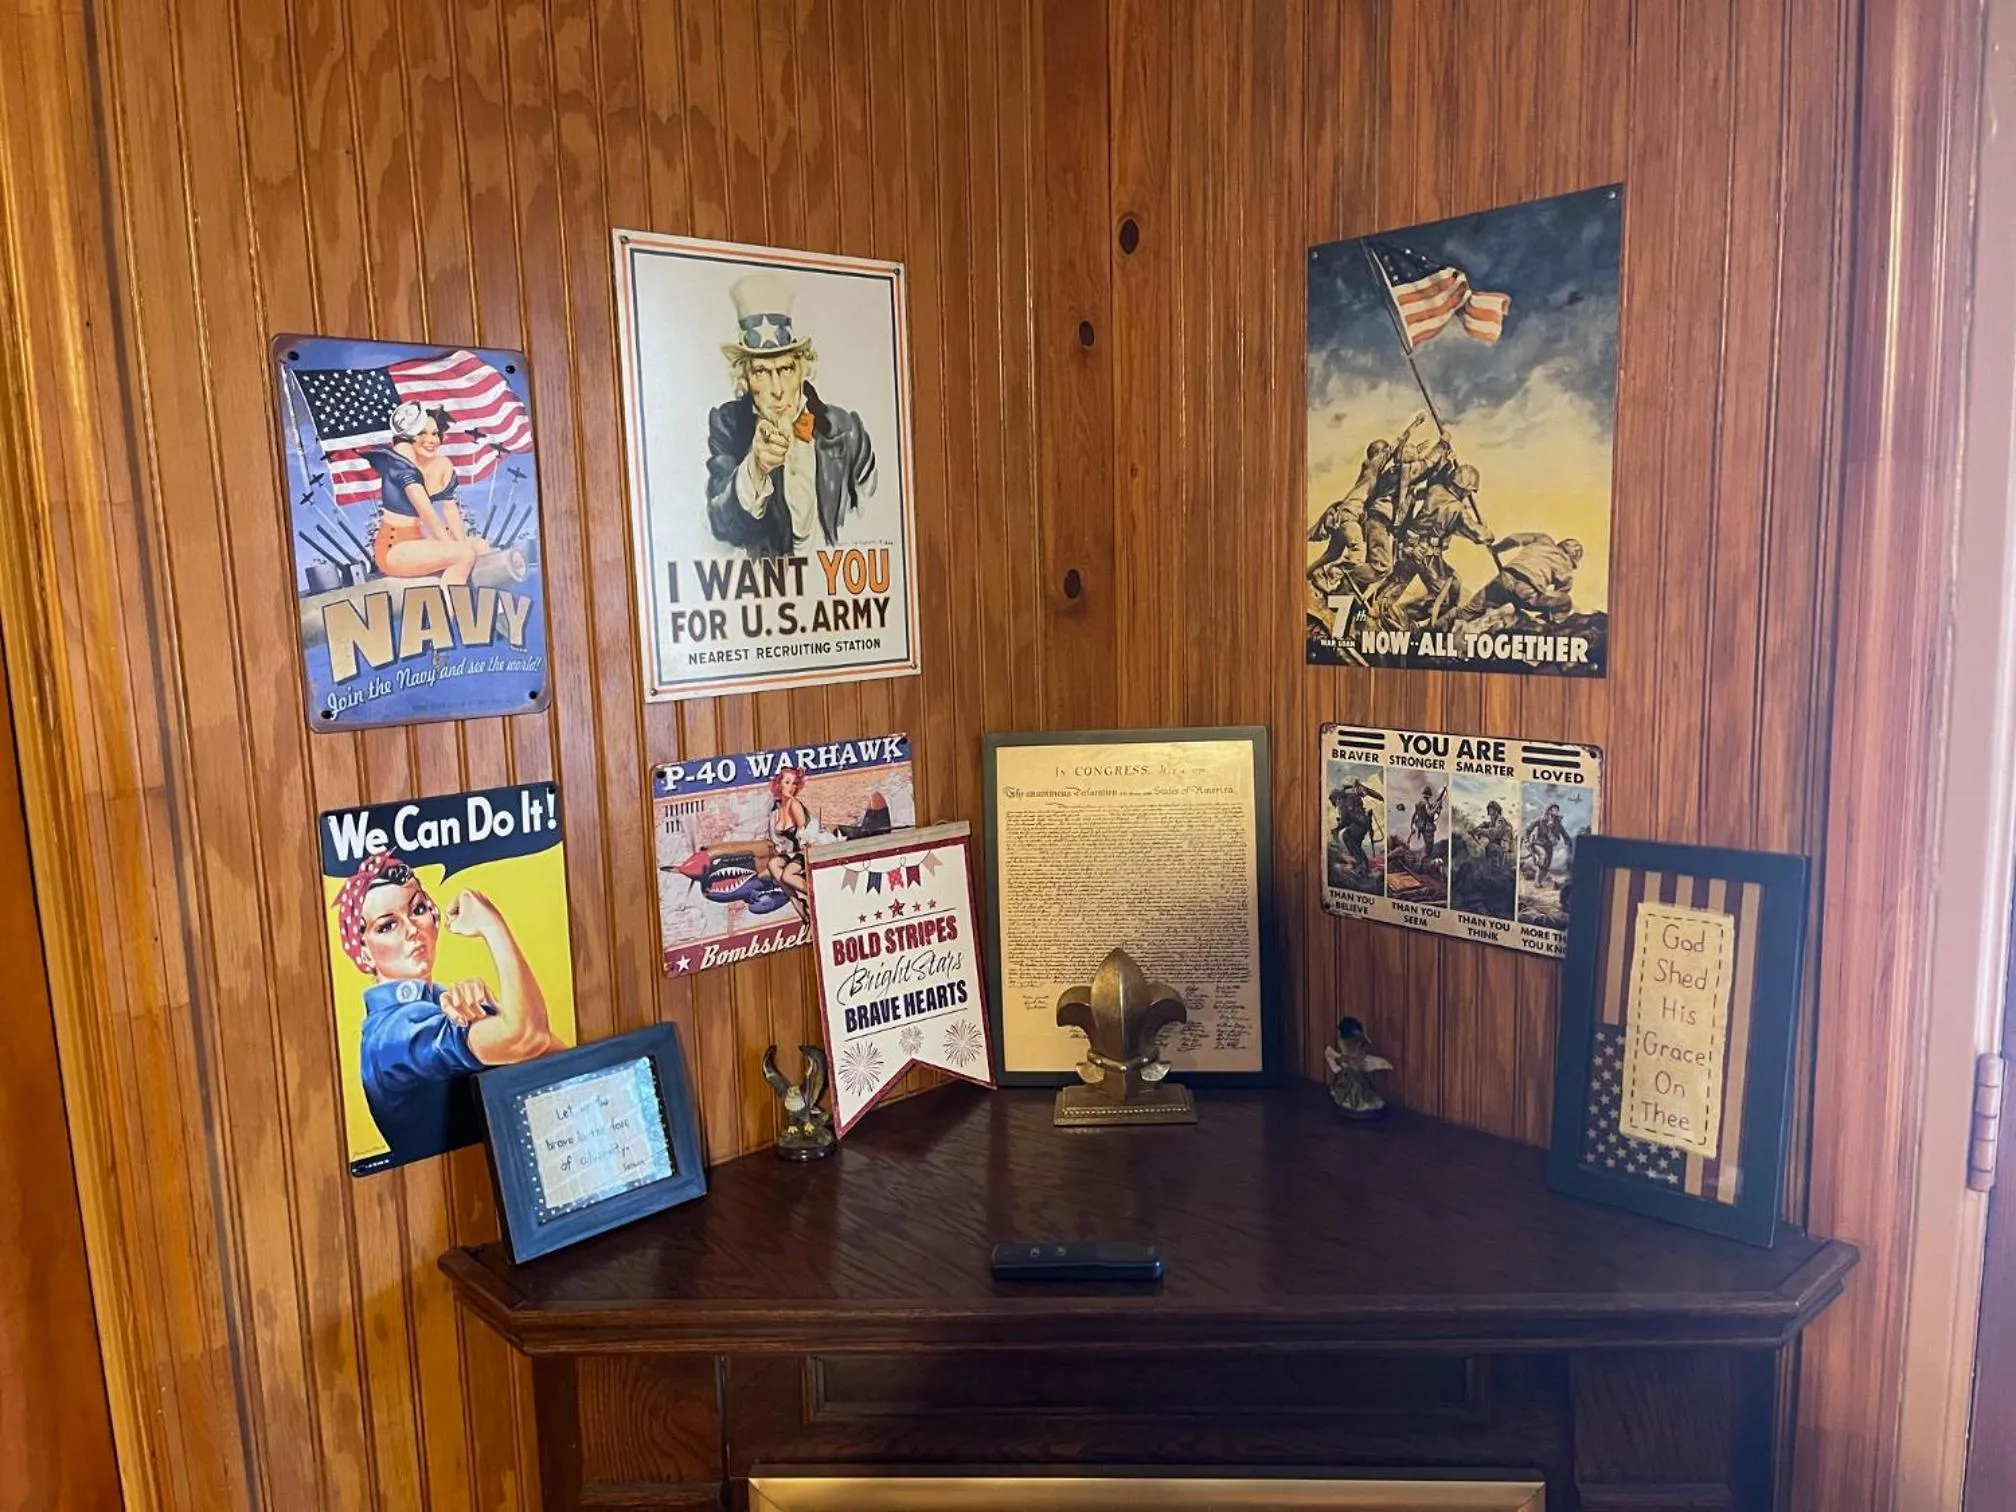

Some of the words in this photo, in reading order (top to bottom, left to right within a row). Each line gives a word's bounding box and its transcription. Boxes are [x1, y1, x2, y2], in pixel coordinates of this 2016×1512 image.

[667, 561, 680, 603] I
[693, 557, 808, 601] WANT
[817, 548, 891, 596] YOU
[322, 584, 533, 684] NAVY
[671, 609, 727, 644] FOR
[688, 649, 750, 665] NEAREST
[756, 643, 831, 659] RECRUITING
[835, 638, 881, 652] STATION
[1464, 633, 1589, 663] TOGETHER
[327, 686, 364, 721] Join
[369, 679, 391, 698] the
[396, 667, 437, 688] Navy
[440, 662, 465, 680] and
[468, 659, 485, 673] see
[487, 654, 505, 671] the
[506, 656, 543, 672] world!
[1331, 748, 1379, 763] BRAVER
[1398, 733, 1449, 758] YOU
[1456, 739, 1506, 762] ARE
[663, 759, 737, 791] P-40
[747, 736, 903, 778] WARHAWK
[1389, 754, 1446, 770] STRONGER
[1455, 761, 1515, 777] SMARTER
[1532, 768, 1585, 784] LOVED
[327, 811, 389, 862] We
[394, 804, 461, 851] Can
[467, 796, 515, 842] Do
[521, 787, 558, 834] It!
[1329, 890, 1355, 901] THAN
[1356, 894, 1376, 906] YOU
[1335, 901, 1369, 915] BELIEVE
[1391, 901, 1419, 914] THAN
[1421, 906, 1441, 919] YOU
[1403, 914, 1428, 927] SEEM
[1458, 914, 1486, 928] THAN
[1488, 919, 1511, 932] YOU
[1467, 927, 1499, 941] THINK
[1520, 927, 1552, 940] MORE
[832, 931, 882, 967] BOLD
[885, 915, 958, 954] STRIPES
[1521, 938, 1544, 950] YOU
[1662, 923, 1706, 953] God
[836, 955, 912, 1006] Bright
[911, 950, 963, 981] Stars
[1654, 958, 1709, 990] Shed
[844, 996, 901, 1033] BRAVE
[903, 979, 969, 1017] HEARTS
[1662, 997, 1697, 1026] His
[1643, 1030, 1706, 1067] Grace
[1655, 1070, 1685, 1097] On
[556, 1103, 573, 1120] Let
[1641, 1101, 1691, 1131] Thee
[545, 1137, 574, 1151] brave
[560, 1155, 572, 1171] of
